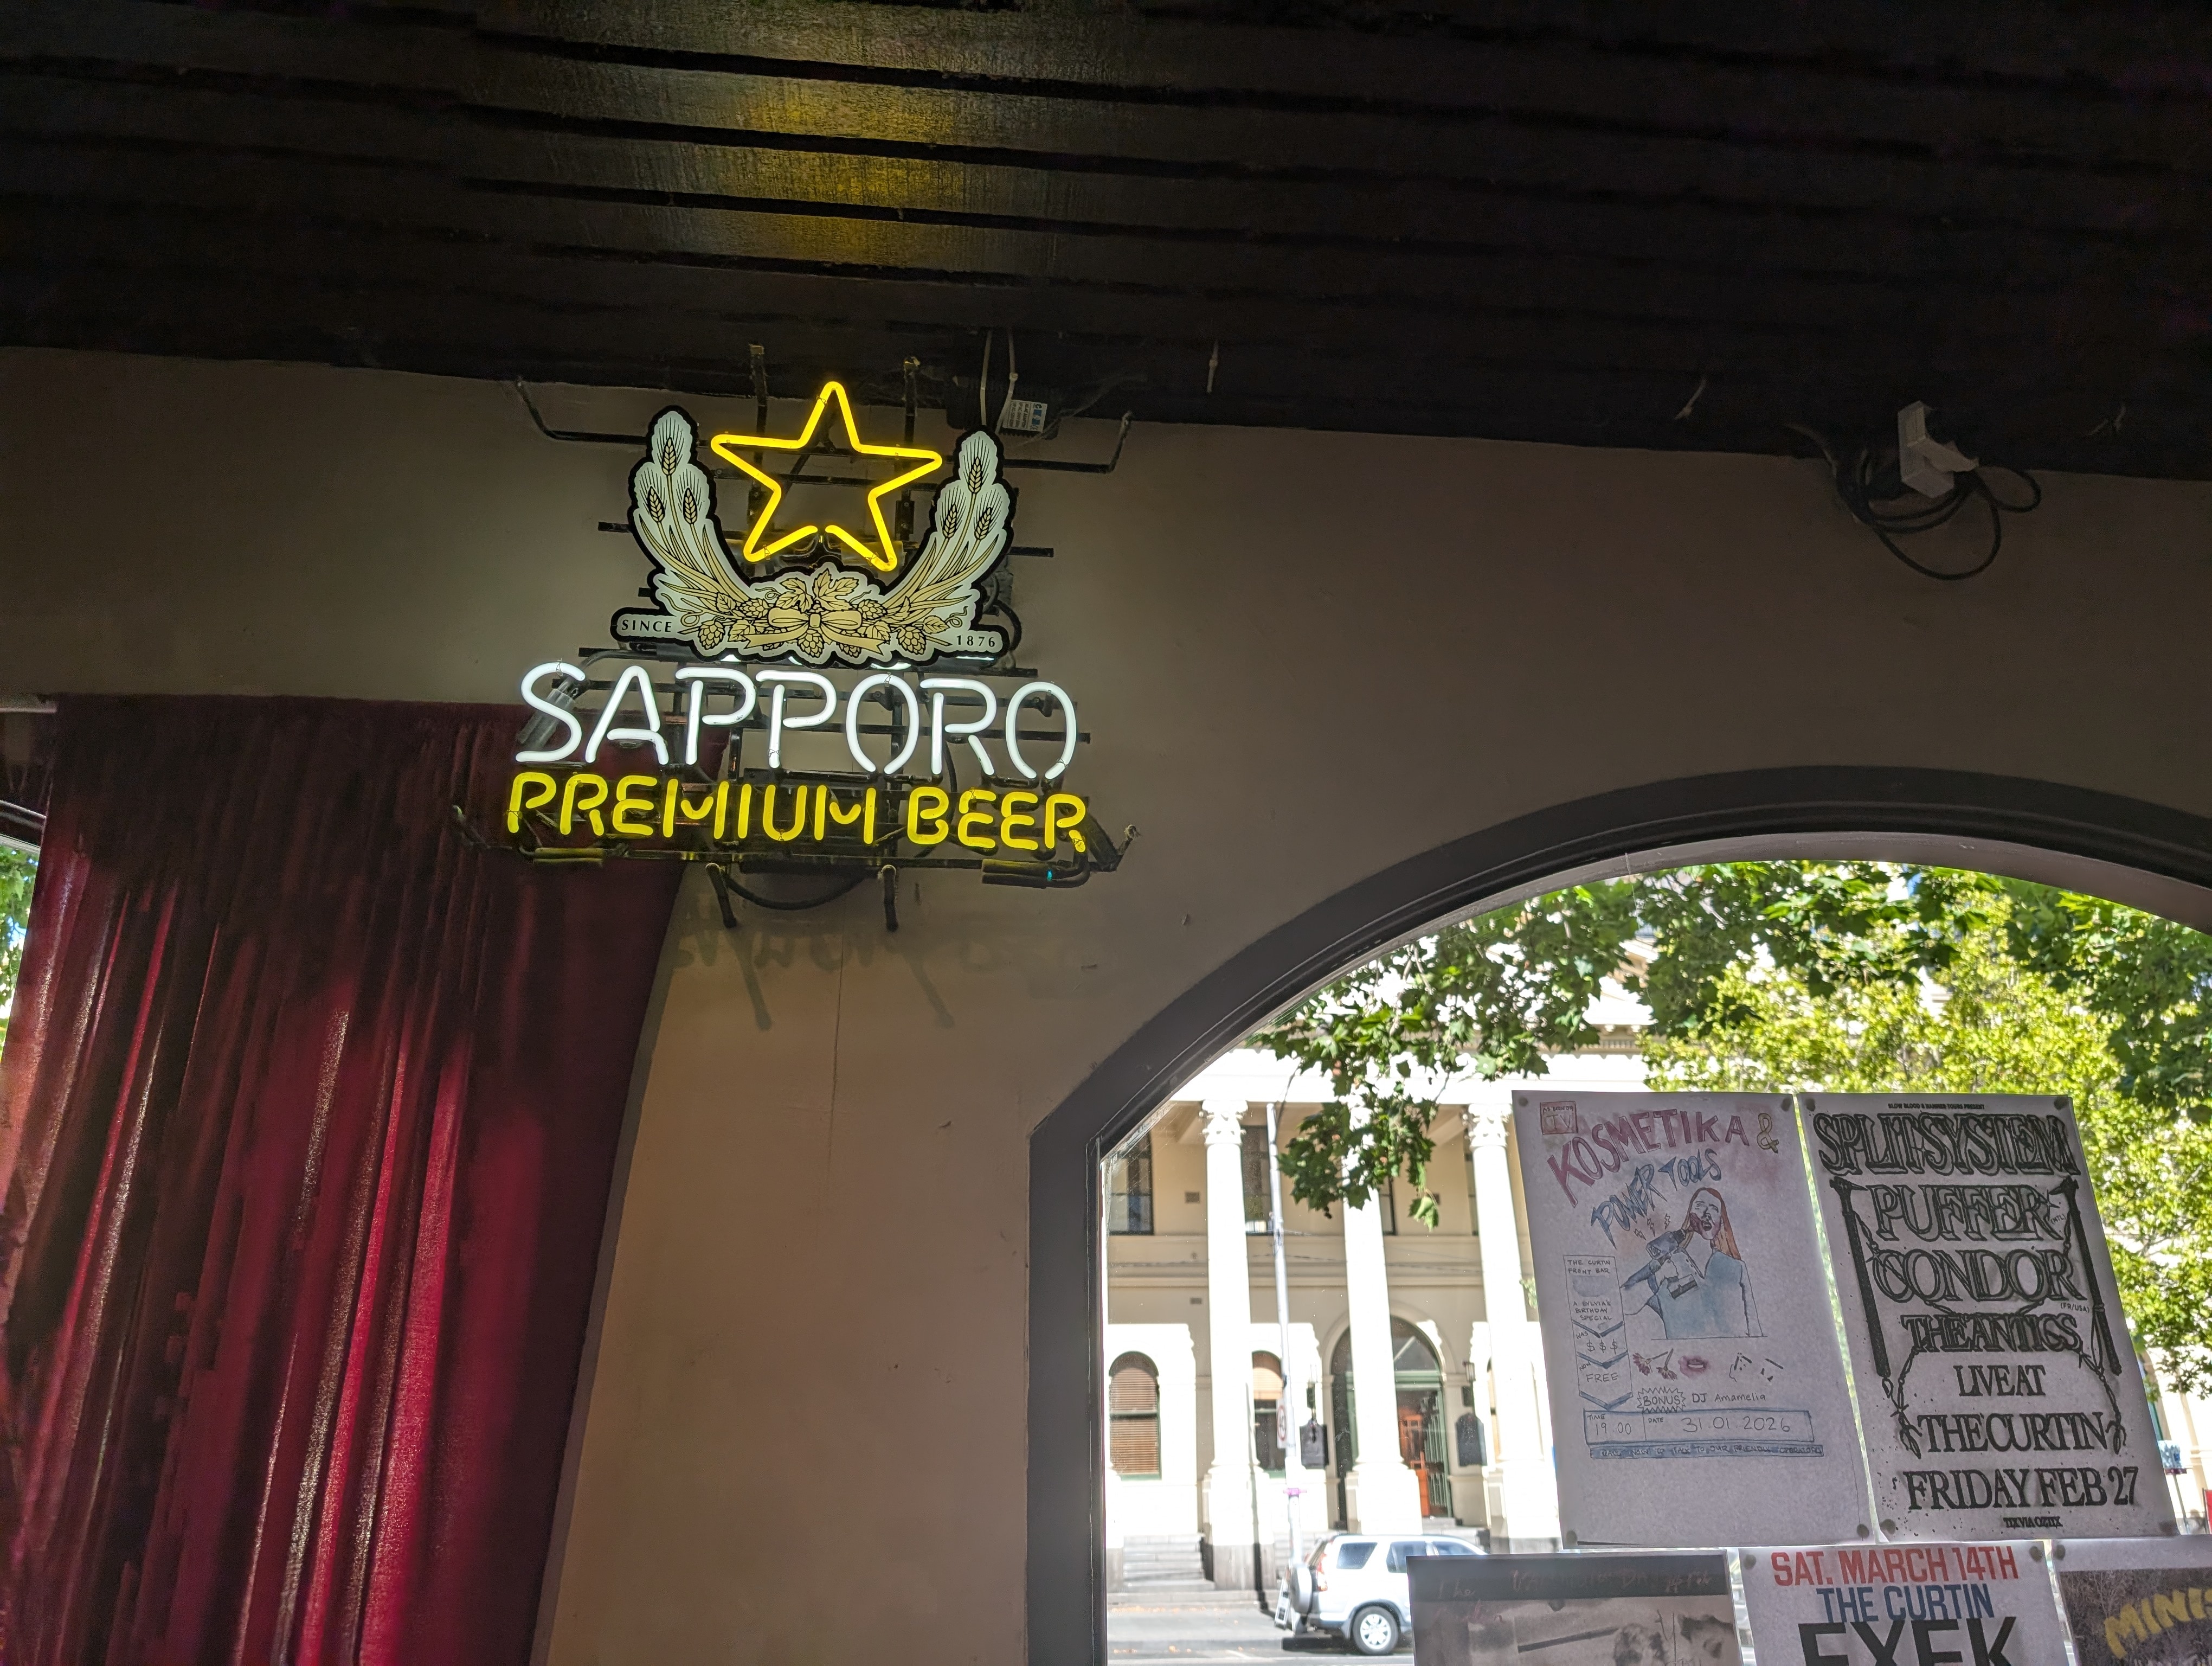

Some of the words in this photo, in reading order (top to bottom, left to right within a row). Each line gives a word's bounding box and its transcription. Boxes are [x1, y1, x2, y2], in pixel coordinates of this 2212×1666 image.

[622, 619, 672, 632] SINCE
[956, 635, 995, 648] 1876
[516, 662, 1077, 779] SAPPORO
[507, 772, 877, 844] PREMIUM
[907, 786, 1086, 852] BEER
[1546, 1114, 1571, 1130] TV
[1547, 1109, 1750, 1208] KOSMETIKA
[1757, 1113, 1779, 1154] &
[1591, 1163, 1667, 1250] POWER
[1658, 1148, 1722, 1191] TOOLS
[1868, 1184, 2064, 1241] PUFFER
[1871, 1249, 2087, 1302] CONDOR
[2061, 1302, 2090, 1313] (FR/USA)
[1576, 1330, 1589, 1340] WAS
[1579, 1360, 1592, 1372] NOW
[1586, 1372, 1618, 1383] FREE
[1953, 1365, 2016, 1396] LIVE
[2016, 1365, 2046, 1396] AT
[1642, 1396, 1680, 1406] BONUS
[1692, 1393, 1707, 1403] DJ
[1714, 1393, 1766, 1402] Amamelia
[1902, 1469, 2031, 1510] FRIDAY
[2034, 1467, 2107, 1507] FEB
[2107, 1466, 2139, 1505] 27
[1771, 1550, 1834, 1586] SAT.
[1838, 1548, 1949, 1585] MARCH
[1952, 1546, 2019, 1581] 14TH
[1816, 1587, 1879, 1623] THE
[1883, 1583, 1995, 1621] CURTIN
